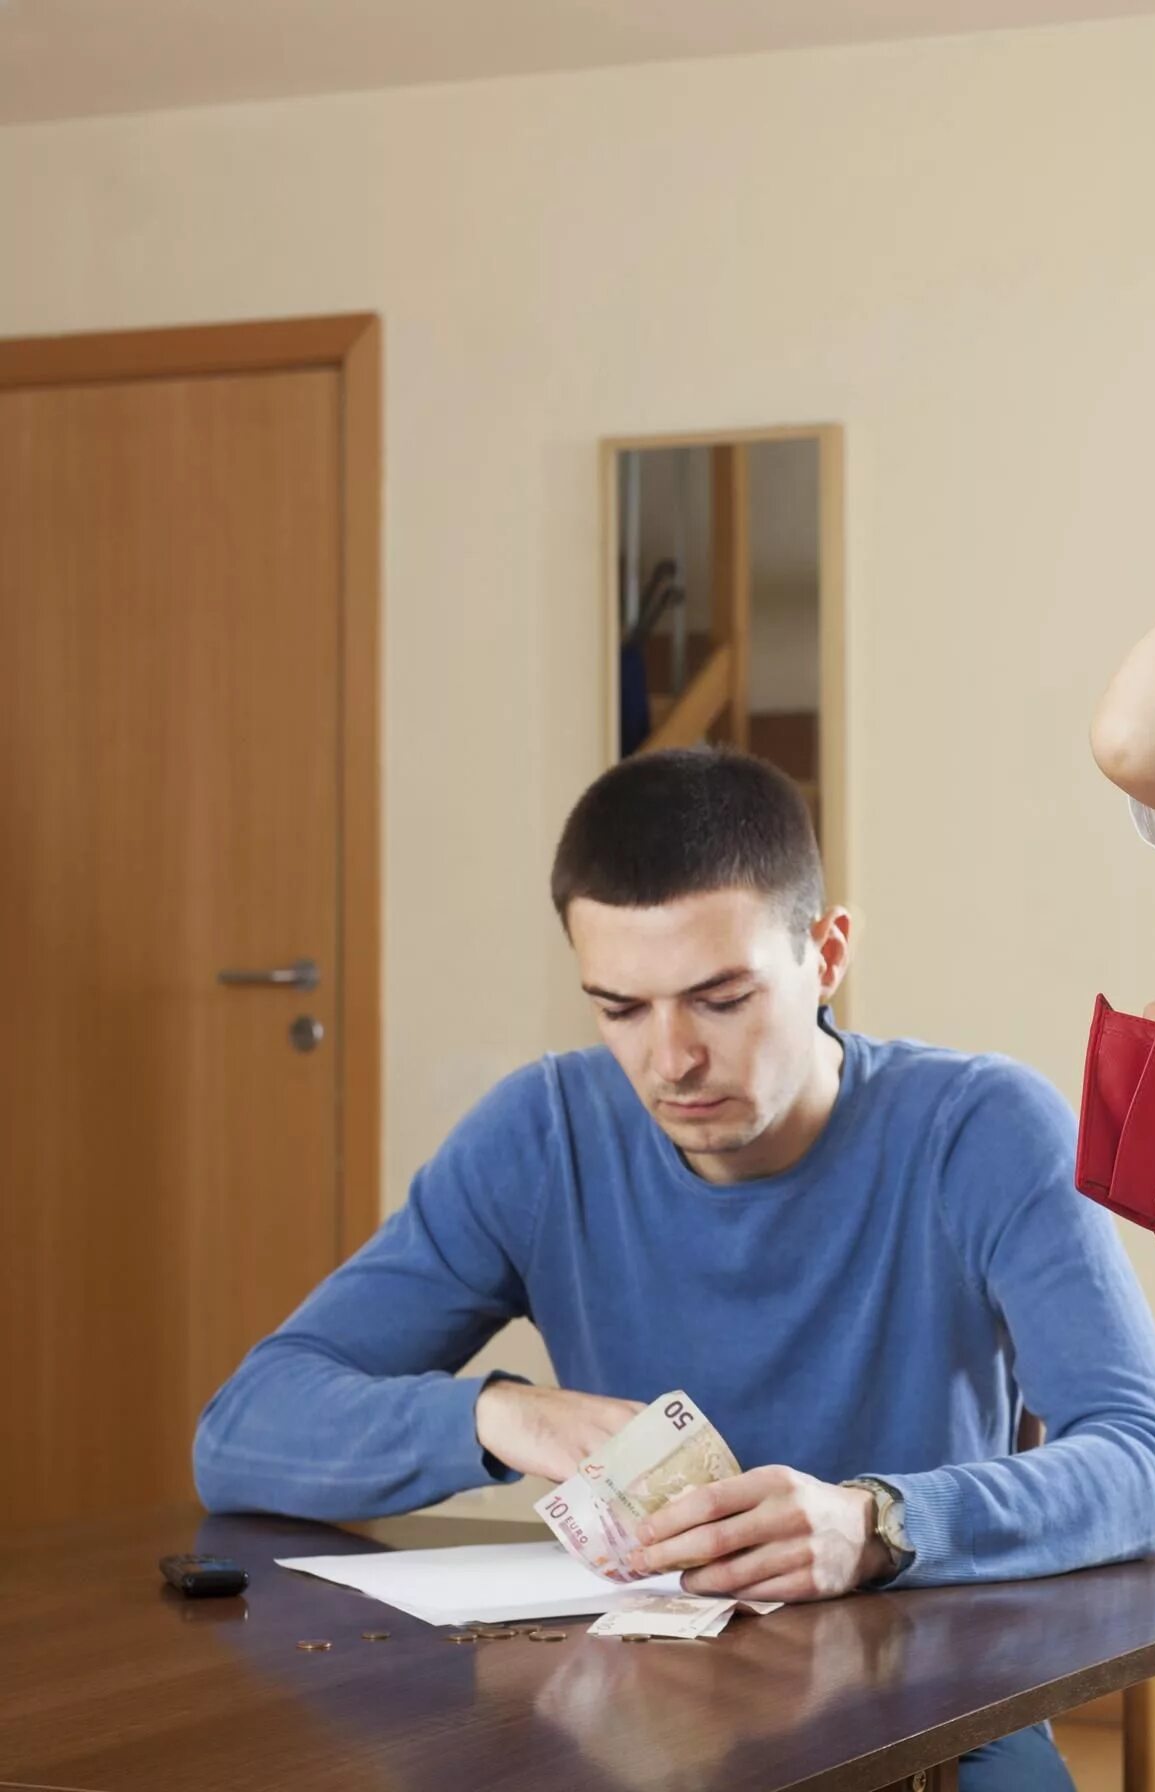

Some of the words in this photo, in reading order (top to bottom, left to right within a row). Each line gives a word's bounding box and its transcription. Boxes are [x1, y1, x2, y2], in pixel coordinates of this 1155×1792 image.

[664, 1400, 693, 1430] 50
[545, 1496, 568, 1518] 10
[564, 1516, 588, 1543] EURO
